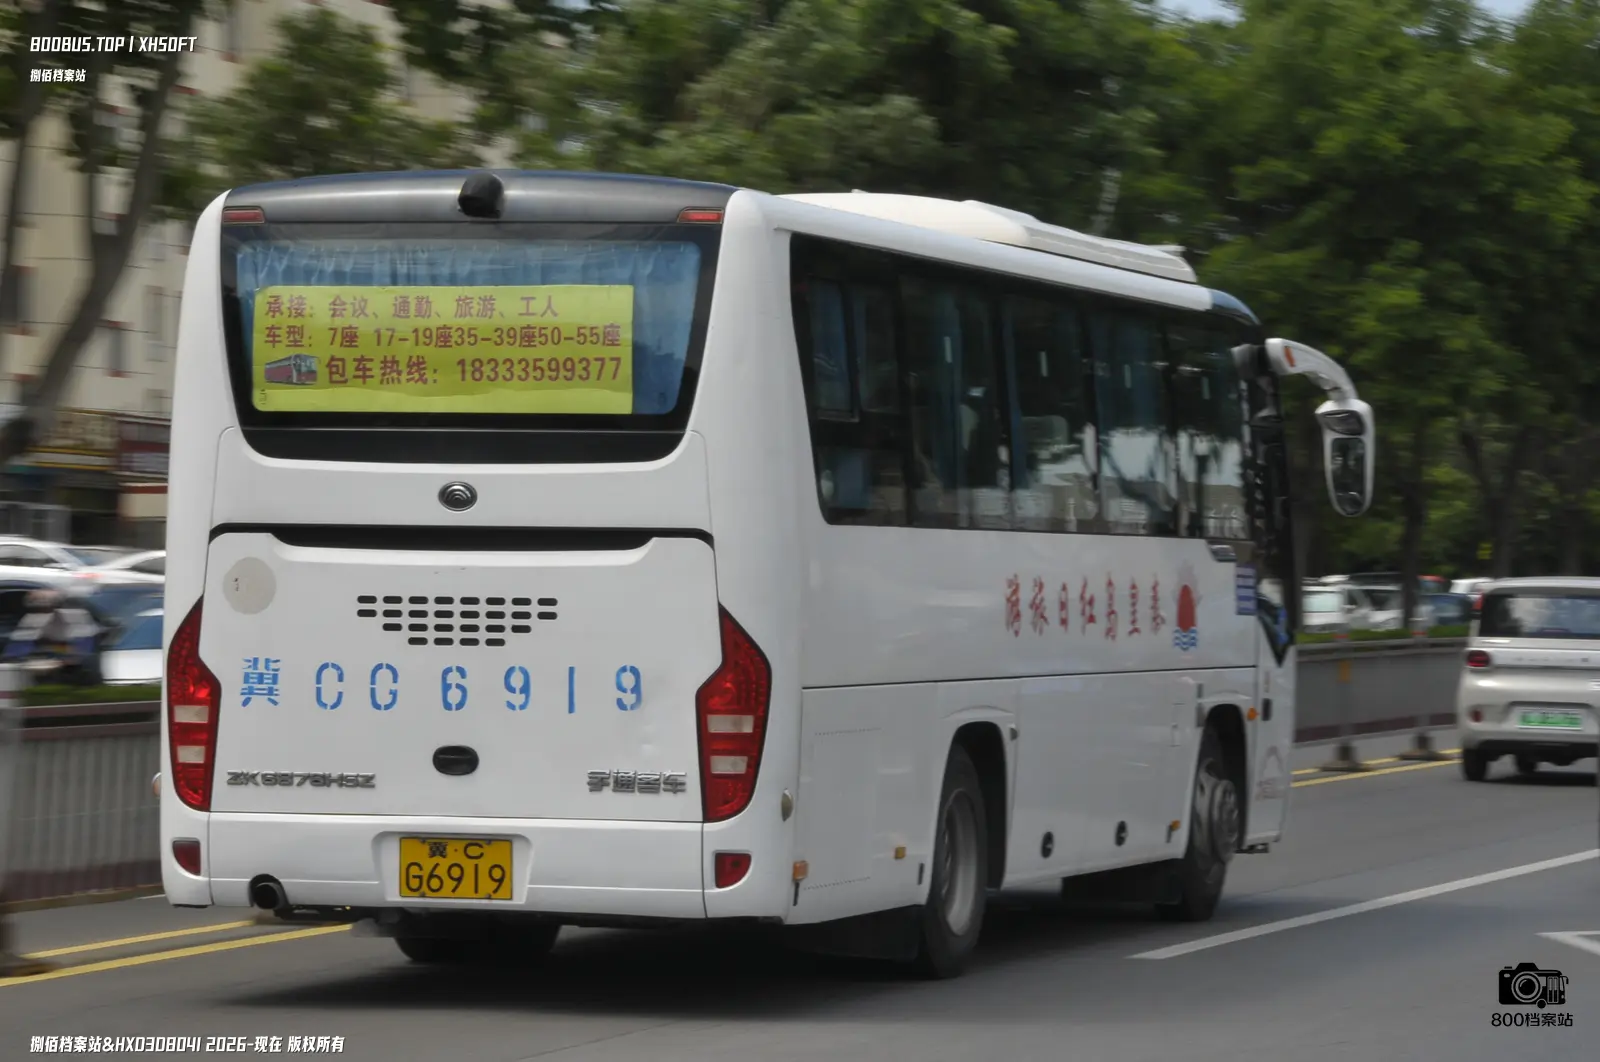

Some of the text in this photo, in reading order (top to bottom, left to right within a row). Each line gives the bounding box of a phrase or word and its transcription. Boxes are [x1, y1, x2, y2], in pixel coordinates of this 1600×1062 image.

[586, 768, 687, 795] 宇通客车
[405, 861, 506, 895] G6919
